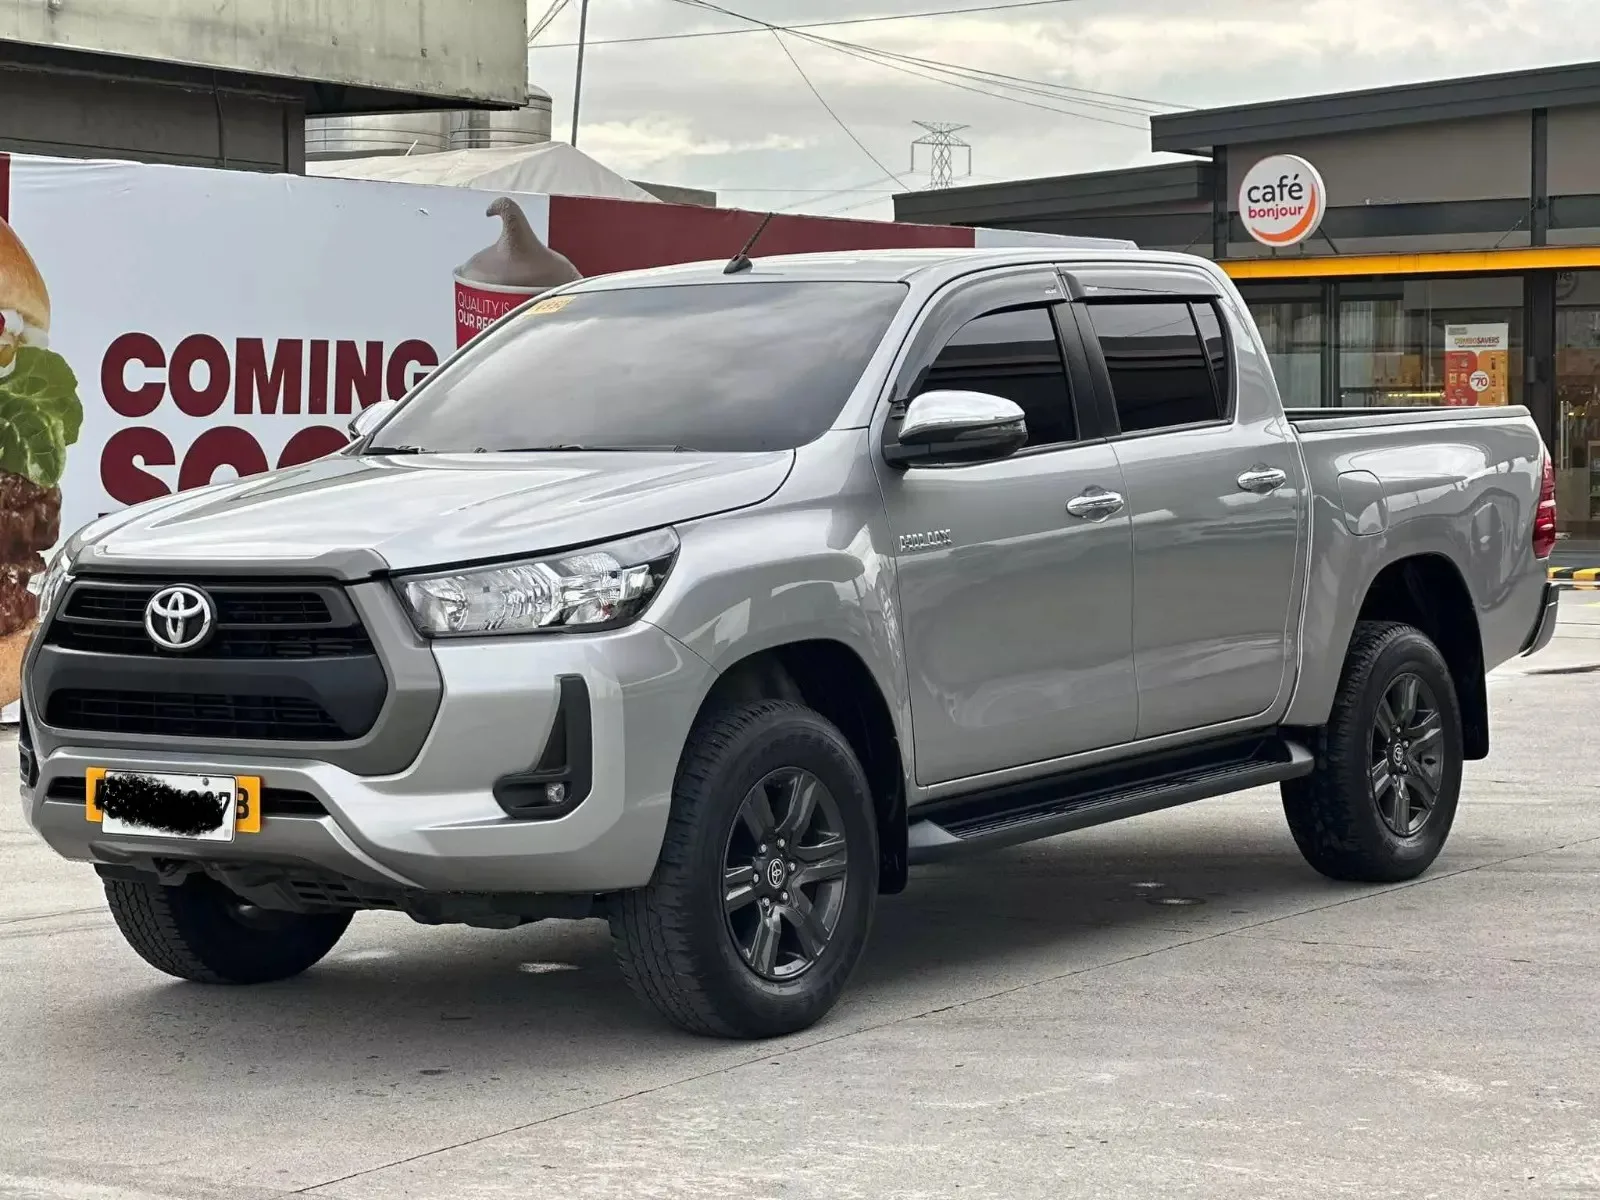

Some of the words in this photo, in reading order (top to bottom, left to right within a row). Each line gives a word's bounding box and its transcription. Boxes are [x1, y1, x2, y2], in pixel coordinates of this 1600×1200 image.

[1247, 174, 1303, 204] café
[1248, 204, 1304, 220] bonjour
[457, 291, 499, 315] QUALITY
[457, 309, 475, 328] OUR
[101, 332, 440, 417] COMING
